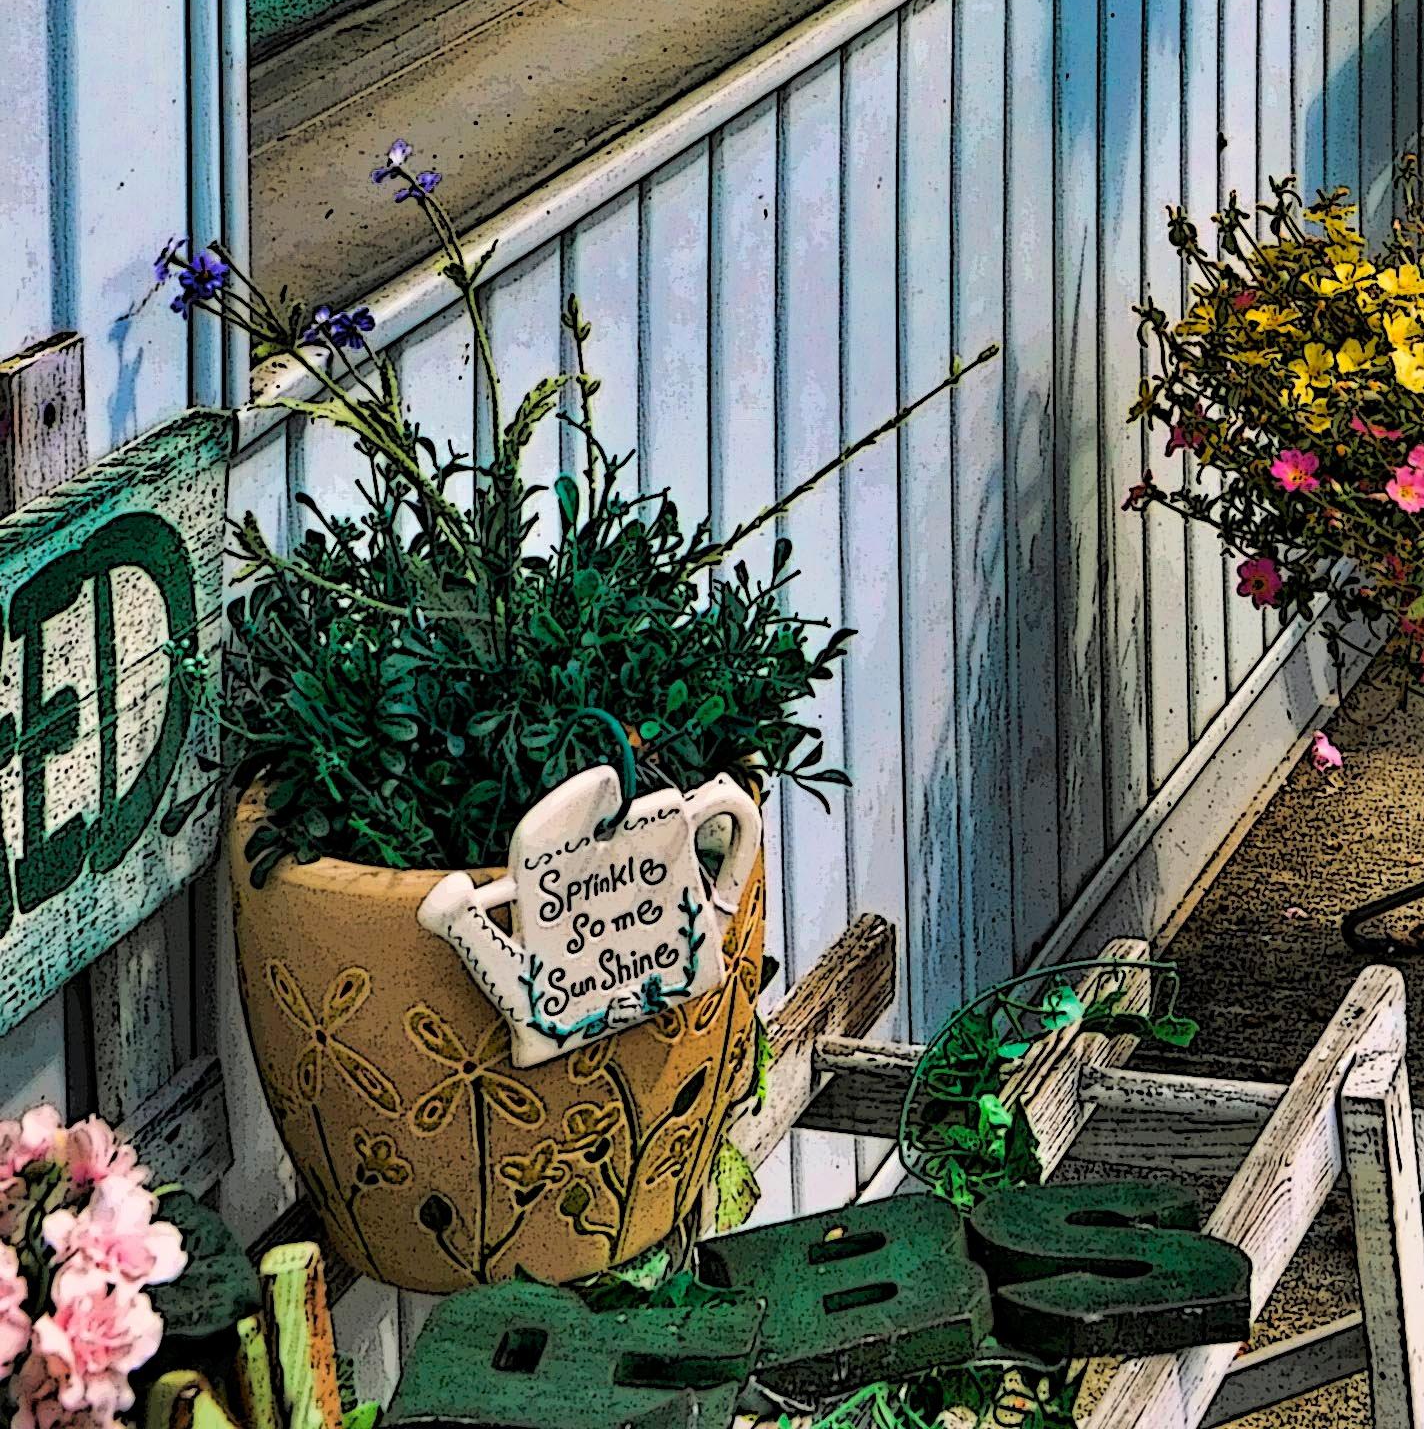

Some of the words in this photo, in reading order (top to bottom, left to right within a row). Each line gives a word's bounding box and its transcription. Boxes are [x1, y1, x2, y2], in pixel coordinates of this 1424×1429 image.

[0, 509, 200, 929] ED
[538, 855, 668, 922] Sprinkle
[566, 899, 664, 955] Some
